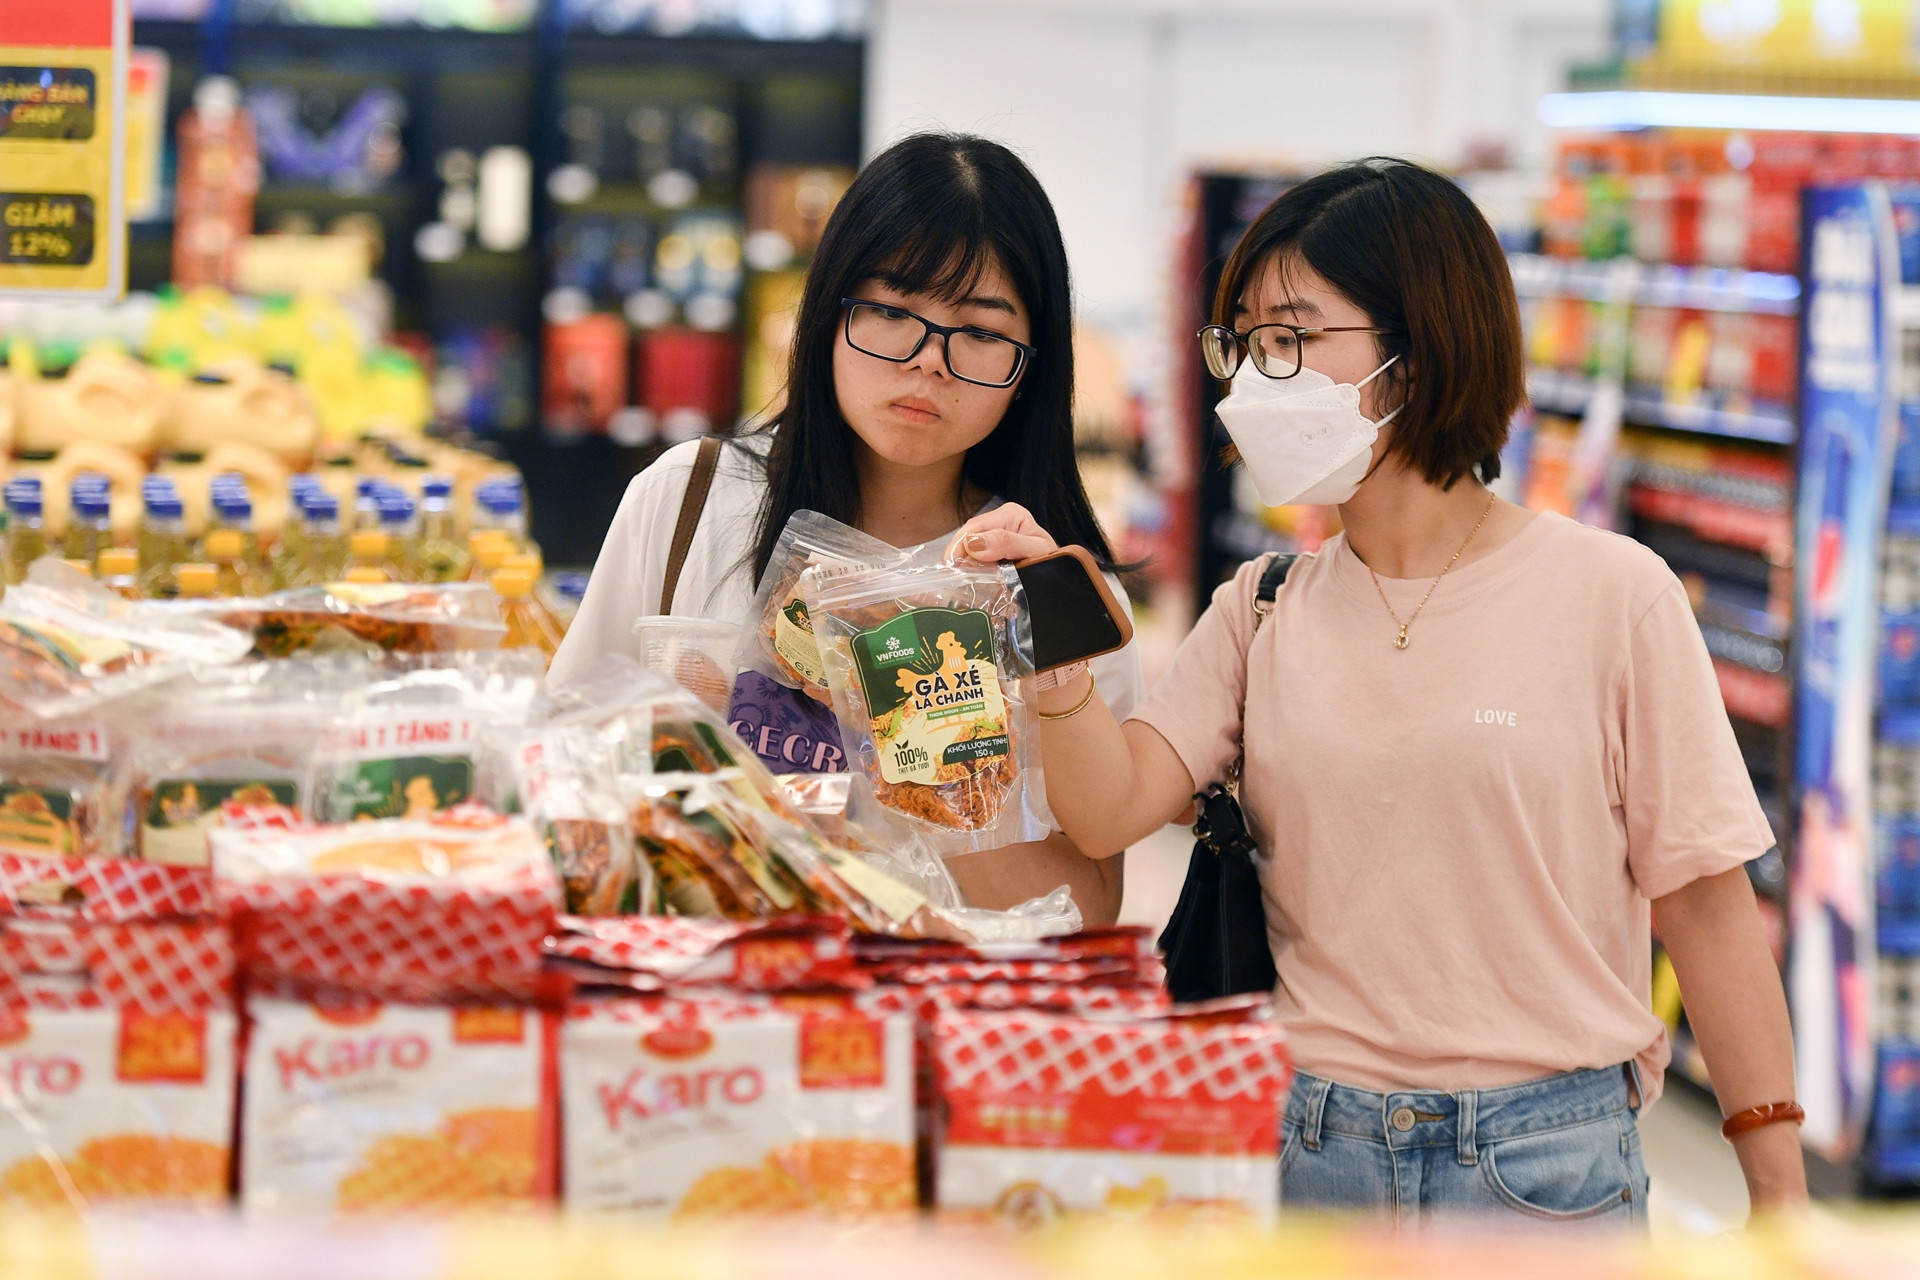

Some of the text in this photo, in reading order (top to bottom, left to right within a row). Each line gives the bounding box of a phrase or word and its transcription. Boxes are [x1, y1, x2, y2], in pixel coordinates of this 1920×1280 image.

[4, 197, 75, 228] GIẢM
[9, 232, 71, 257] 12%
[876, 648, 915, 662] VNFOODS
[915, 664, 982, 696] GÀ XÉ
[935, 687, 984, 706] CHANH
[1475, 709, 1517, 727] LOVE
[894, 746, 929, 768] 100%
[974, 748, 989, 758] 150
[274, 1035, 431, 1090] Karo
[599, 1066, 764, 1131] Karo
